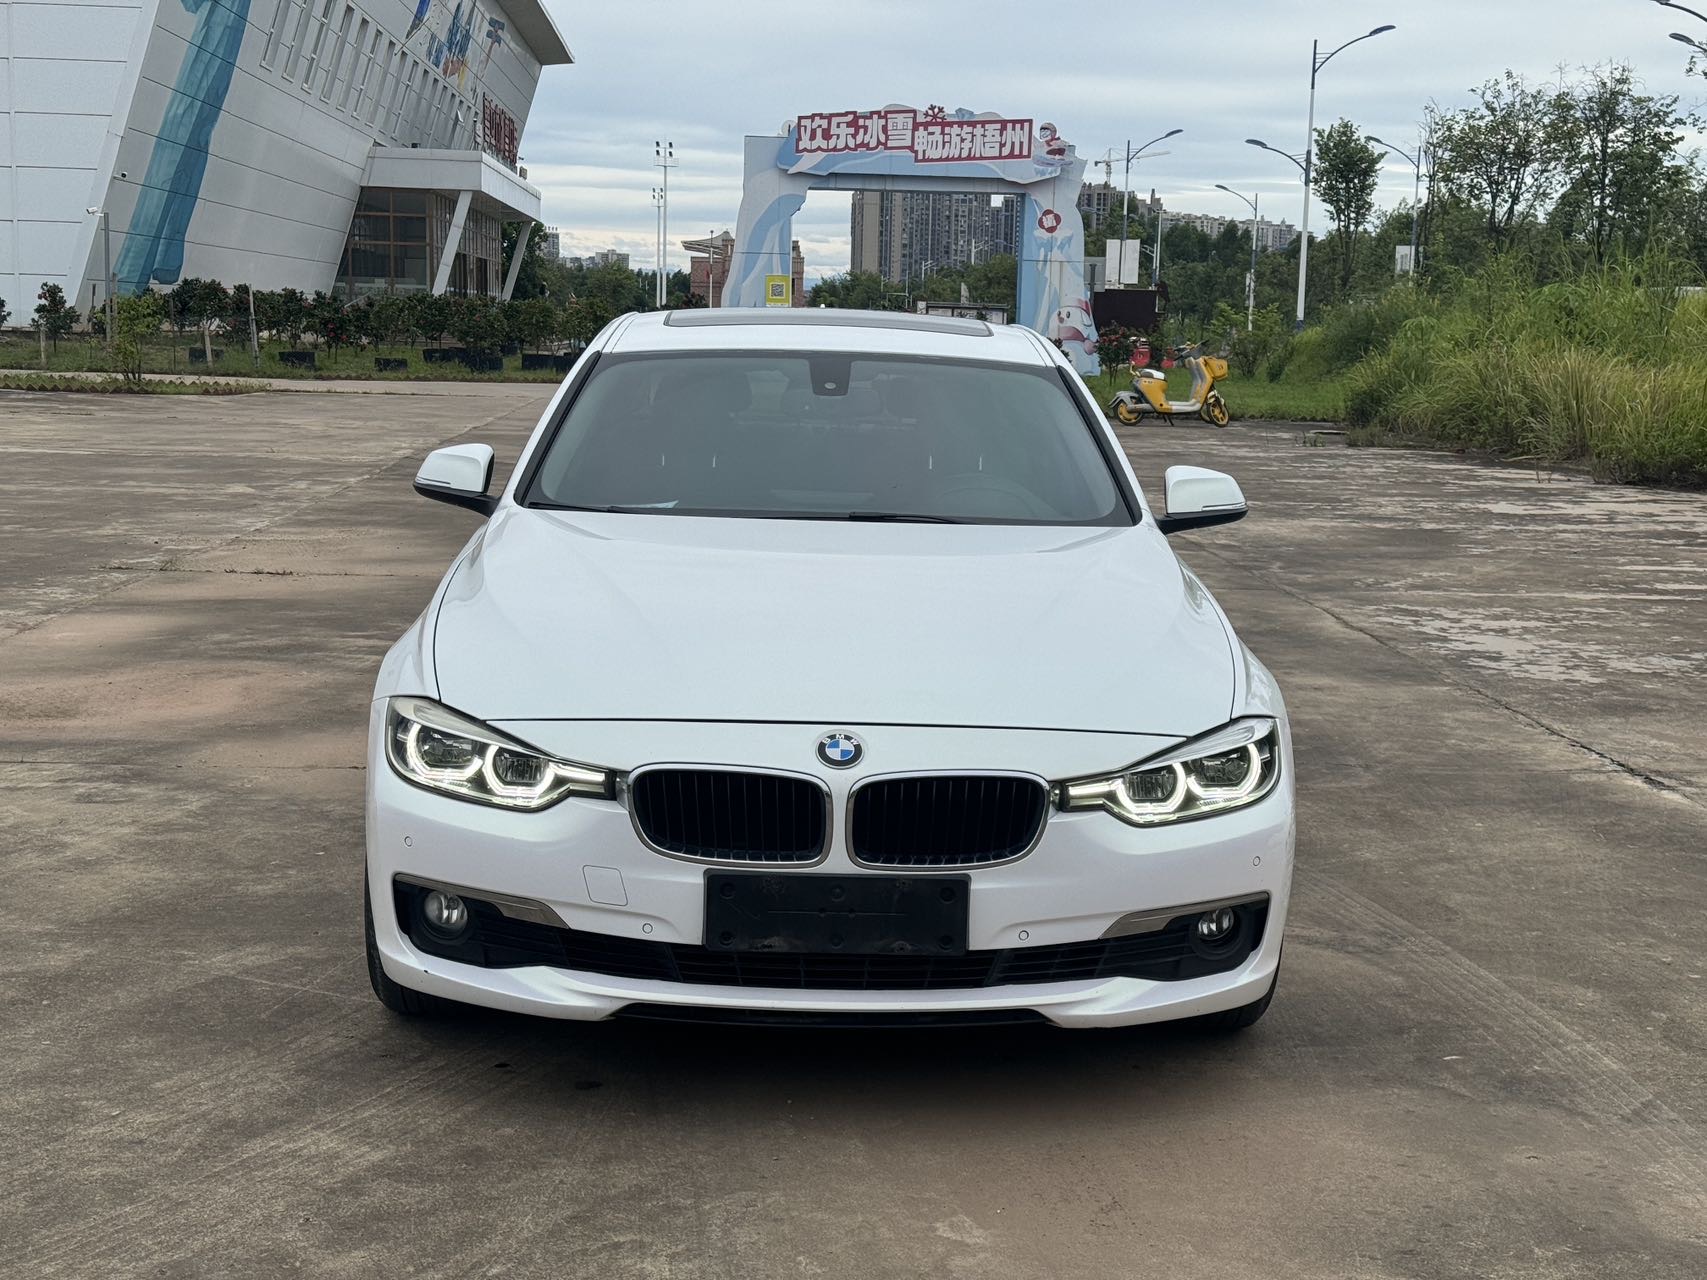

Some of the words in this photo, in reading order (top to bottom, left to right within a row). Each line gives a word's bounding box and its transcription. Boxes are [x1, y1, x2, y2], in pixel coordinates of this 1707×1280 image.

[799, 113, 914, 150] 欢乐冰雪
[914, 122, 1029, 160] 畅游梧州
[822, 733, 860, 746] BMW
